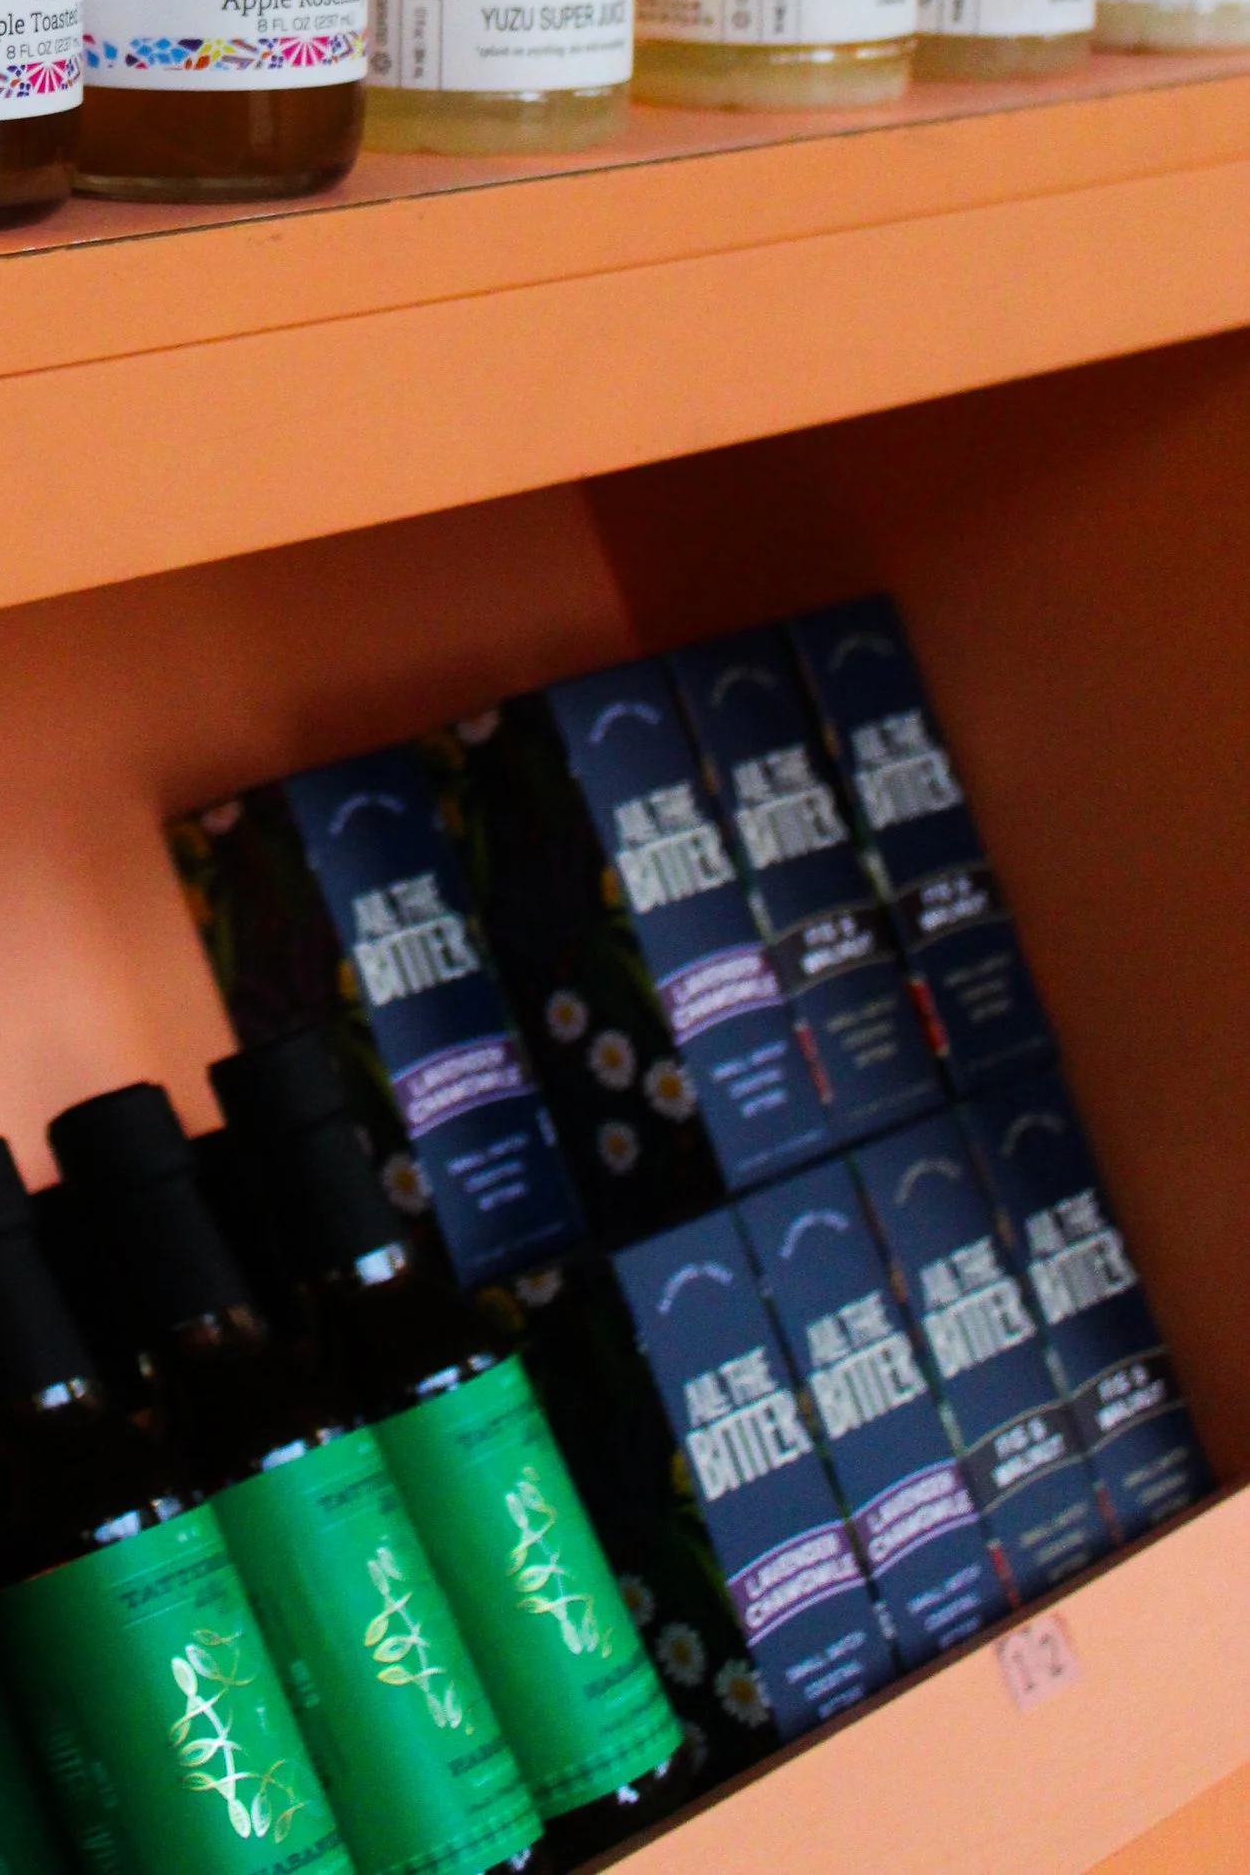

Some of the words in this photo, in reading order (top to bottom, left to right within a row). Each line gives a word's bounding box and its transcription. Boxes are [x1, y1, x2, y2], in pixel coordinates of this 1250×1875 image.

[6, 45, 15, 59] 8
[20, 43, 34, 58] FL
[38, 40, 52, 56] OZ
[257, 18, 268, 33] 8
[481, 6, 534, 32] YUZU
[540, 3, 594, 30] SUPER
[353, 915, 481, 1006] BITTER
[1028, 1227, 1139, 1325] BITTER
[806, 1311, 854, 1367] ALL
[838, 1290, 896, 1348] THE
[922, 1275, 1037, 1380] BITTER
[683, 1367, 732, 1427] ALL
[720, 1345, 778, 1406] THE
[809, 1330, 929, 1442] BITTER
[686, 1388, 816, 1502] BITTER
